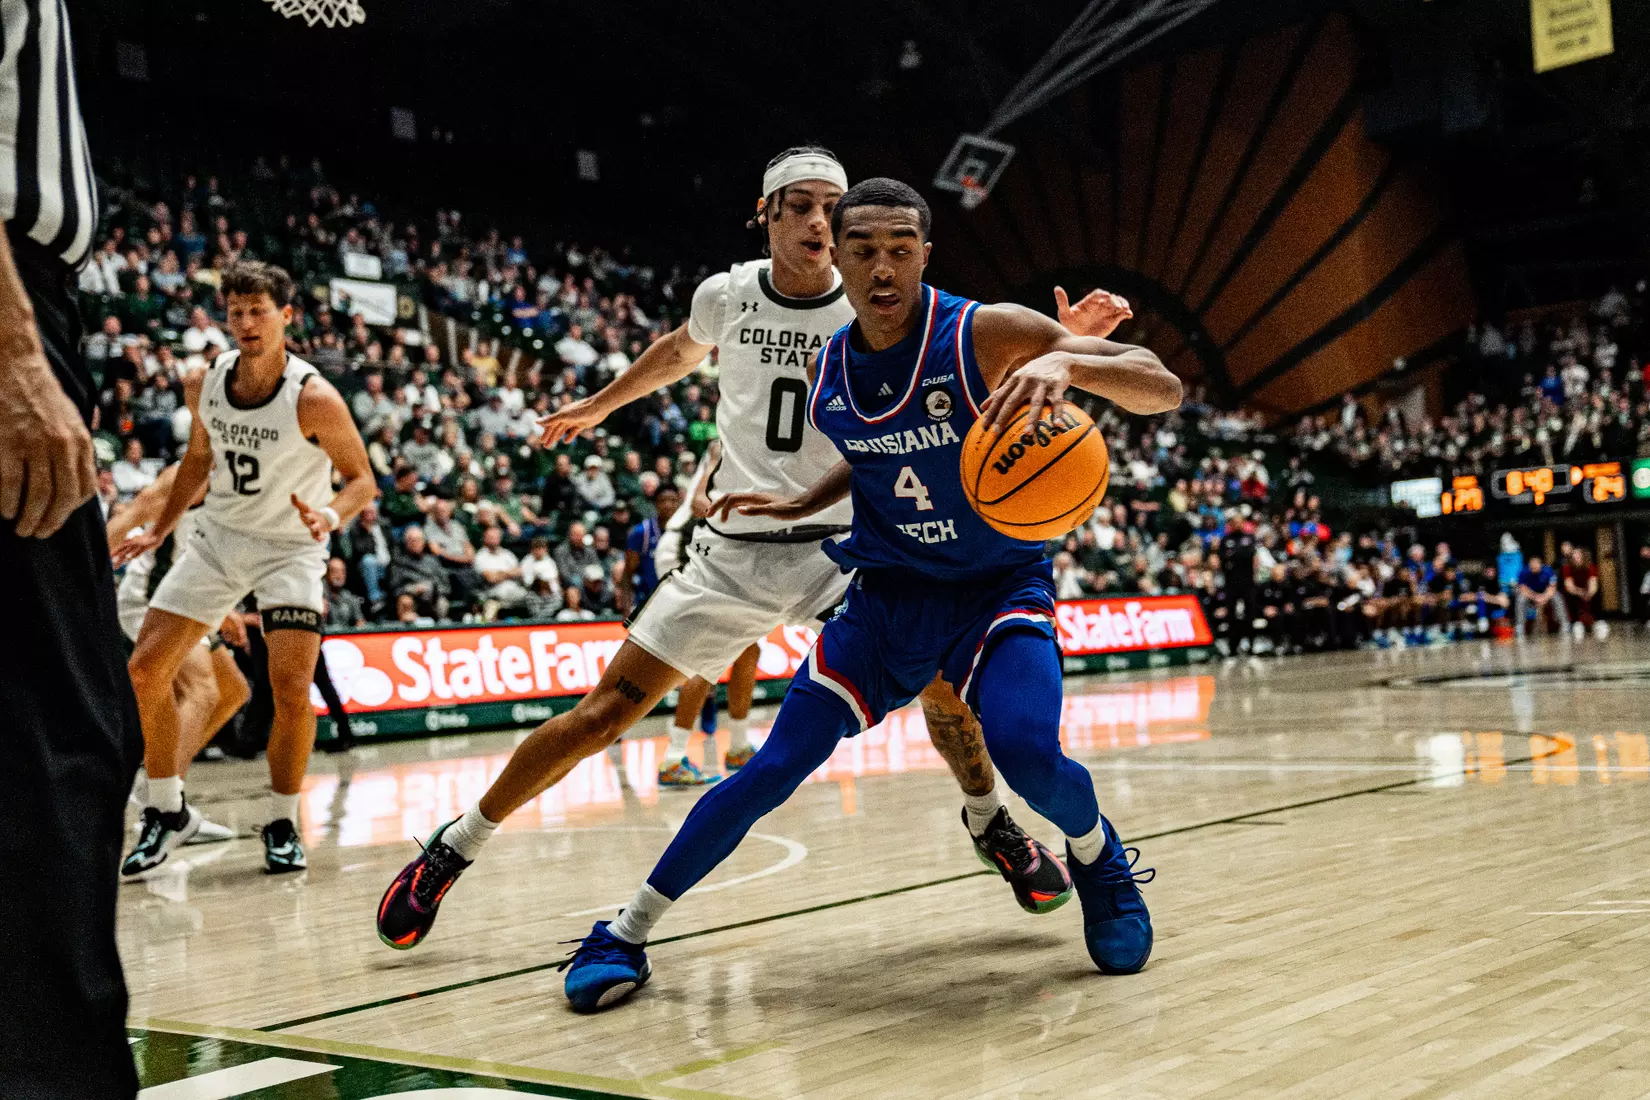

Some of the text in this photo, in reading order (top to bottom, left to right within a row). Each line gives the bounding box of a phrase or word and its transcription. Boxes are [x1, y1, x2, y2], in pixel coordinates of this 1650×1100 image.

[740, 328, 832, 350] COLORA
[760, 347, 813, 368] STAT
[765, 376, 808, 453] 0
[825, 404, 848, 412] adidas
[211, 417, 280, 442] COLORADO
[220, 432, 262, 450] STATE
[843, 421, 961, 456] LOUISIANA
[224, 450, 261, 496] 12
[893, 465, 935, 511] 4
[271, 609, 318, 626] RAMS
